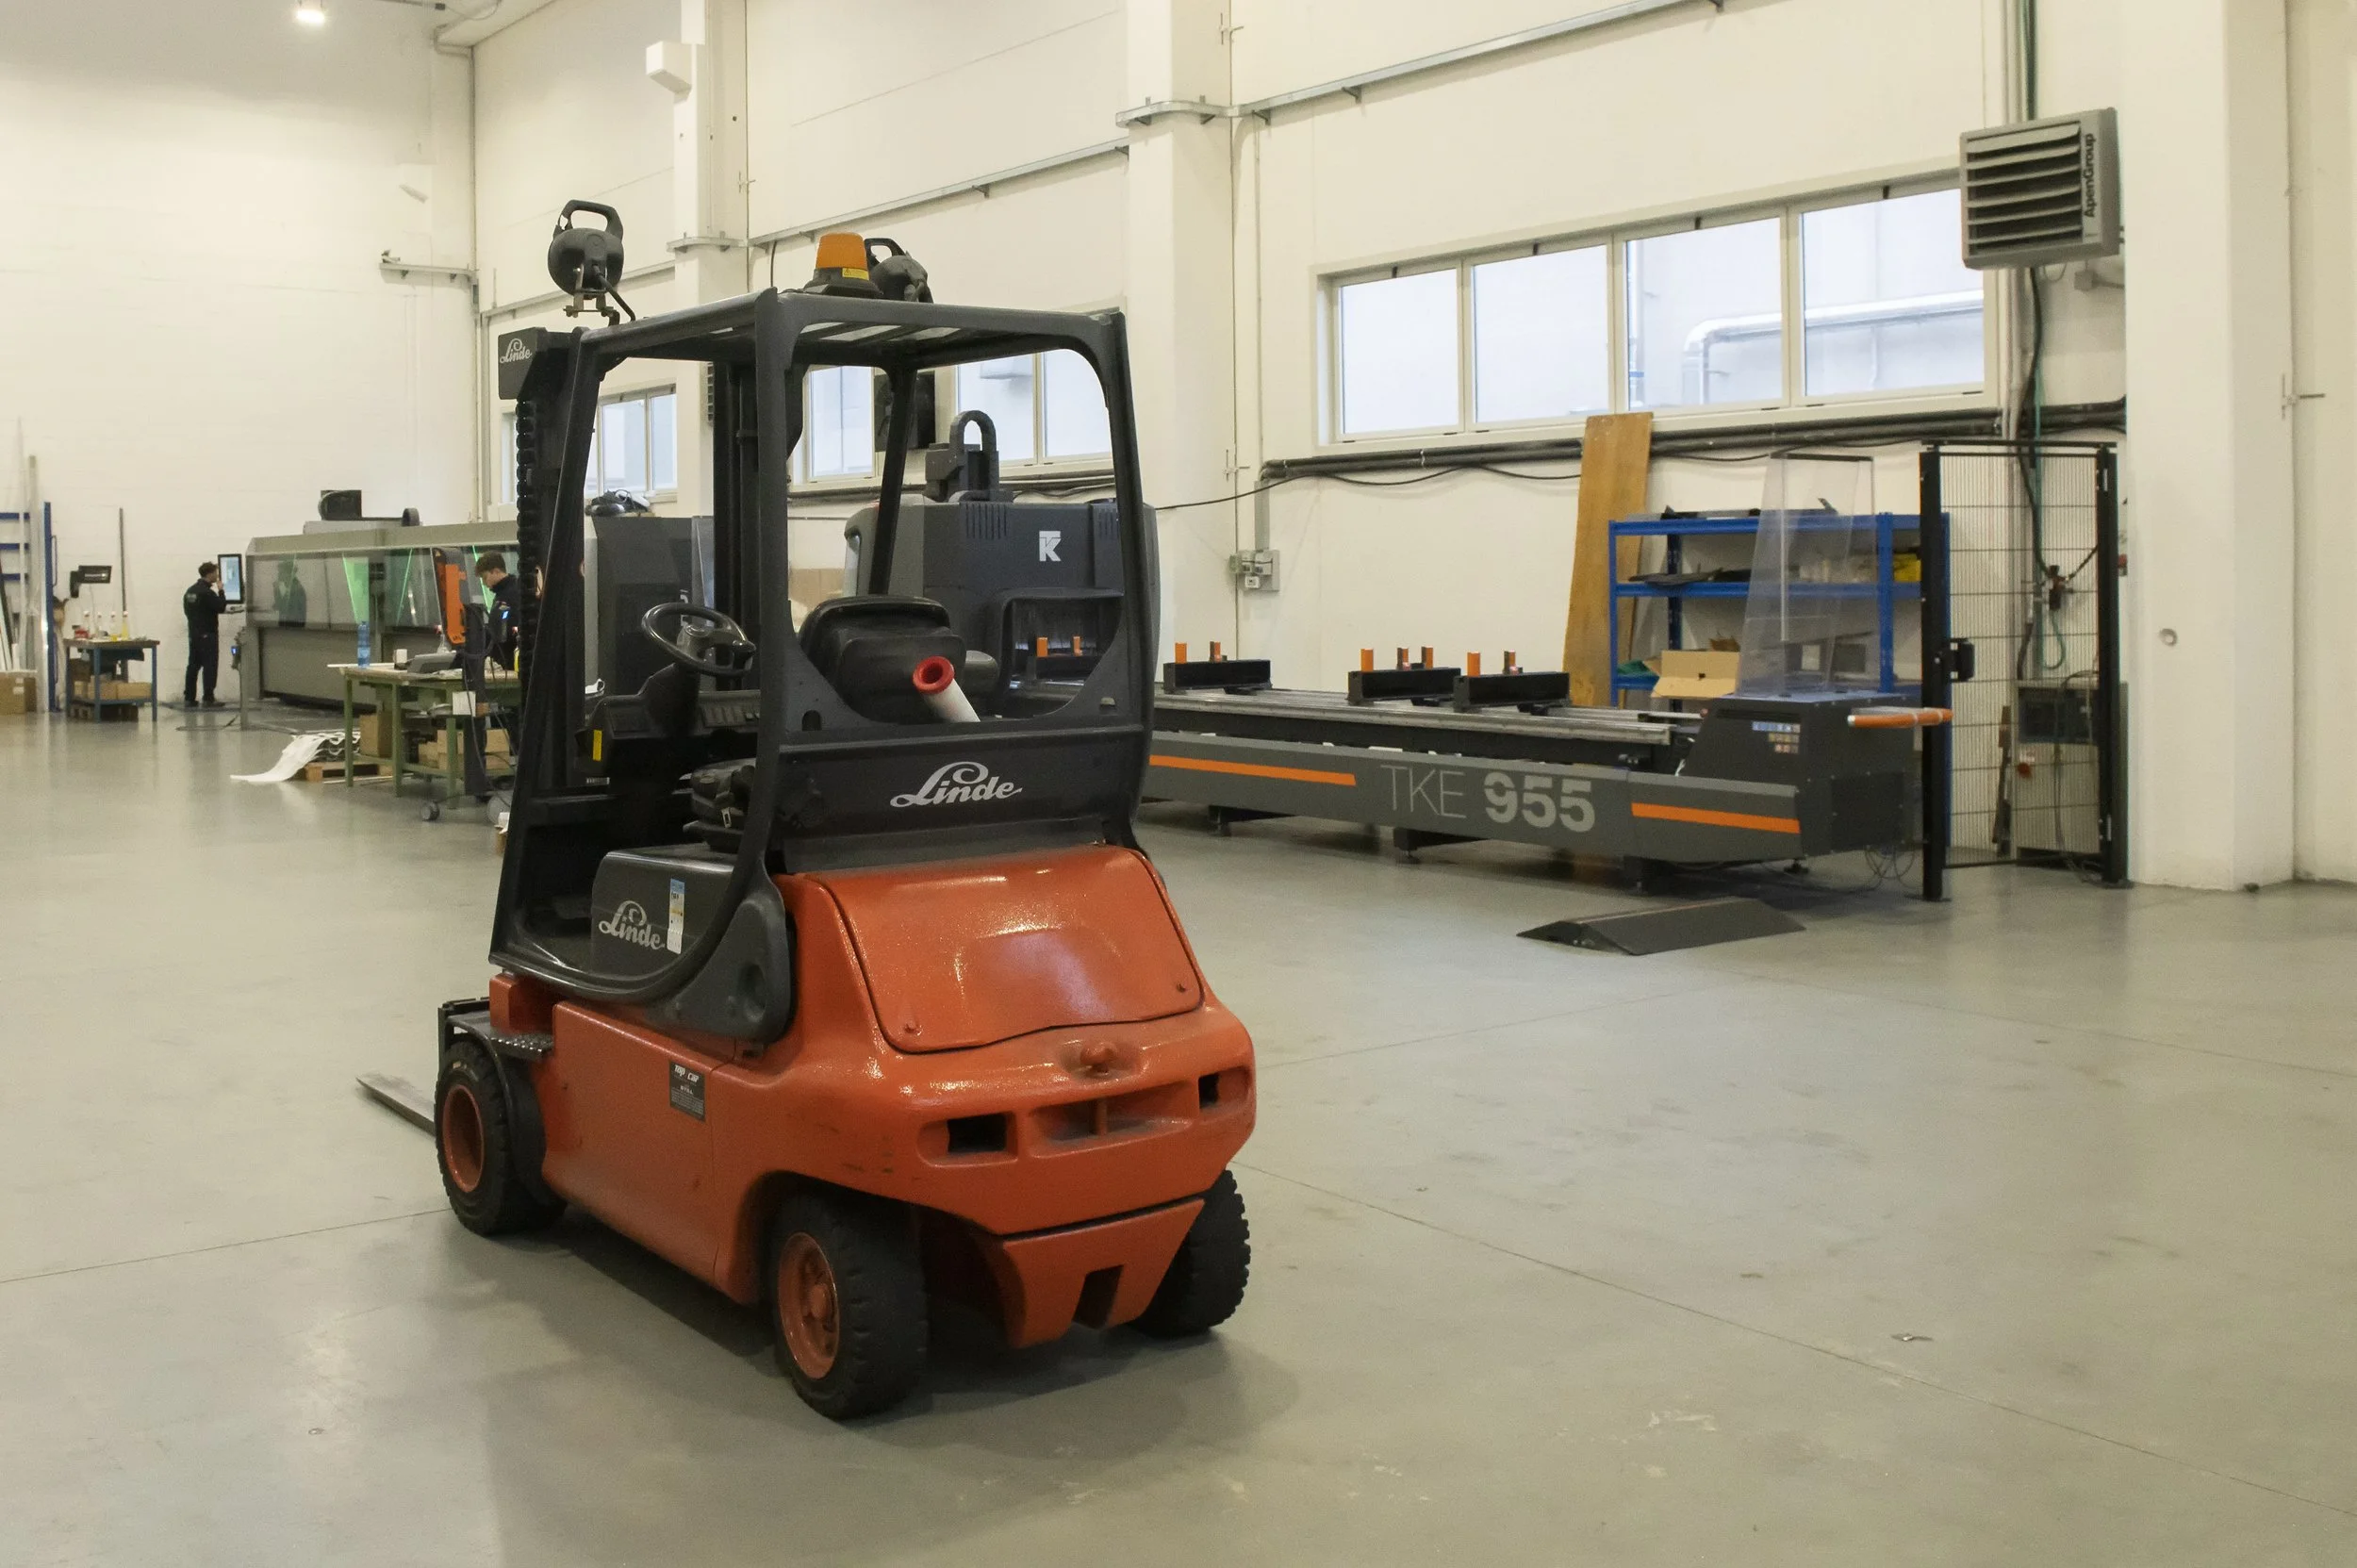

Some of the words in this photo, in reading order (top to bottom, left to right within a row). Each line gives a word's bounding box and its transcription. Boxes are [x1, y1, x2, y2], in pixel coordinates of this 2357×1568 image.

[2083, 133, 2097, 218] ApenGroup
[500, 338, 533, 363] Linde
[890, 761, 1023, 807] Linde
[1380, 765, 1467, 818] TKE
[1483, 771, 1595, 833] 955
[598, 900, 665, 950] Linde
